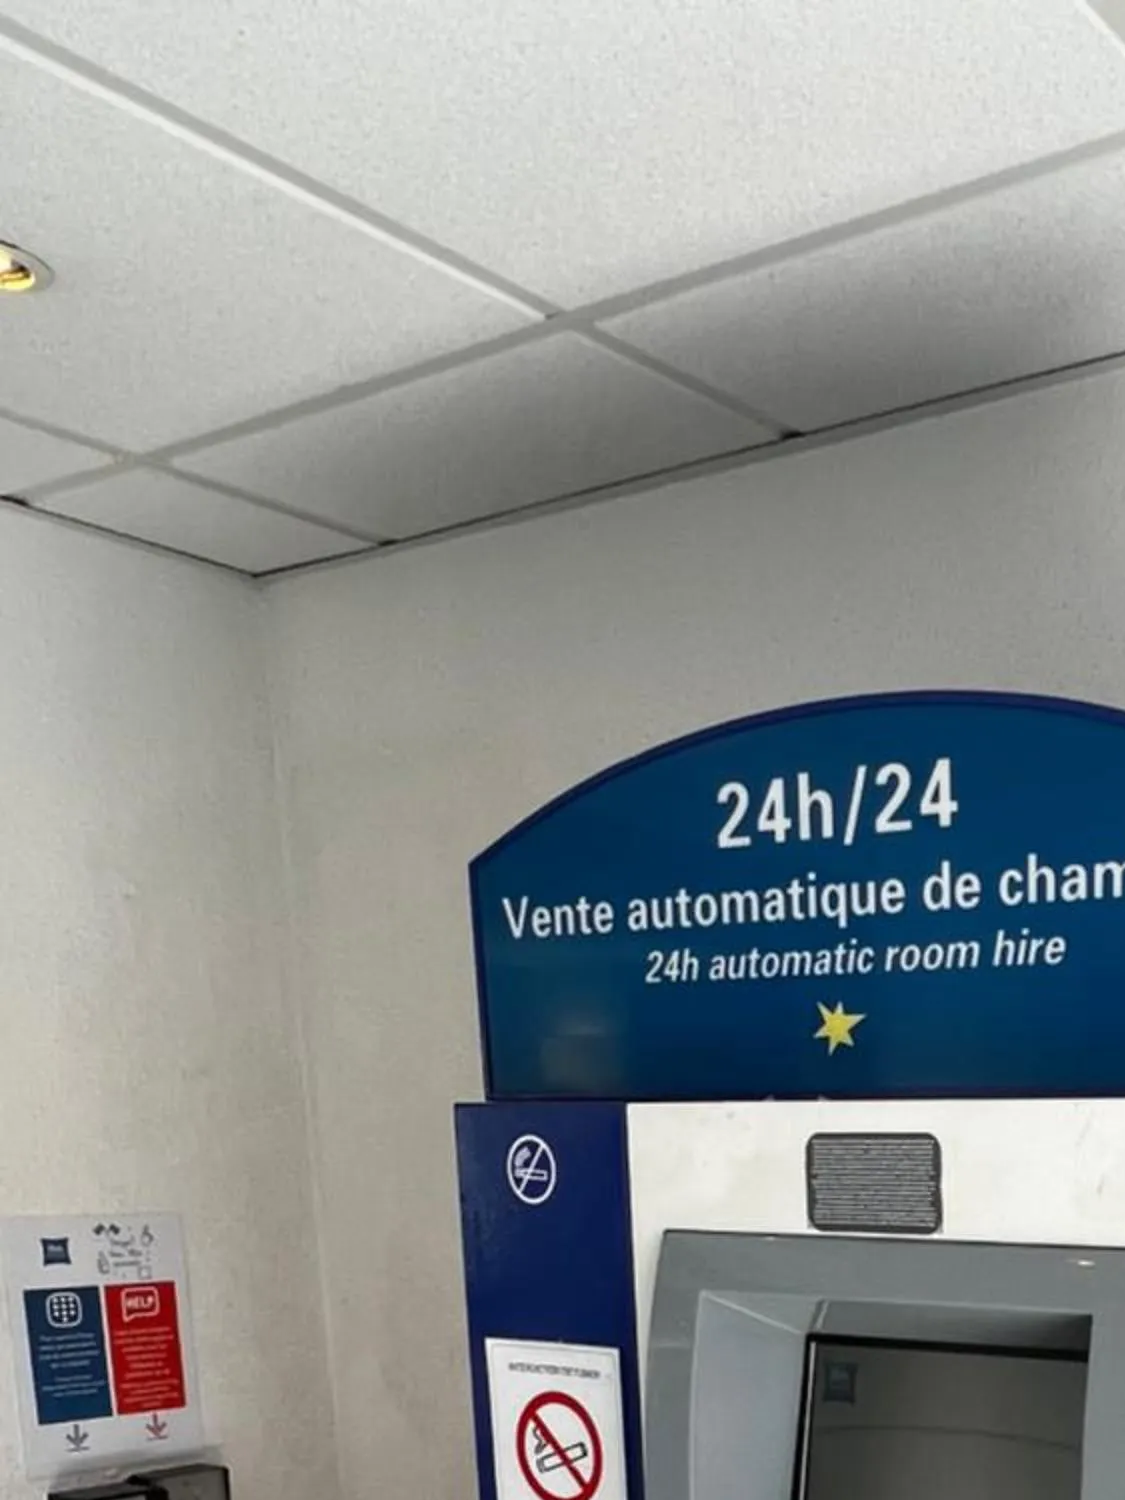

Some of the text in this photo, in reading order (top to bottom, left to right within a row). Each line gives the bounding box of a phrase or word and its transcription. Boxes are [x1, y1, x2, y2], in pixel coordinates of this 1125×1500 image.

[717, 758, 958, 848] 24h/24
[502, 895, 614, 938] Vente
[628, 871, 905, 928] automatique
[923, 860, 981, 911] de
[645, 929, 1066, 983] 24h automatic room hire
